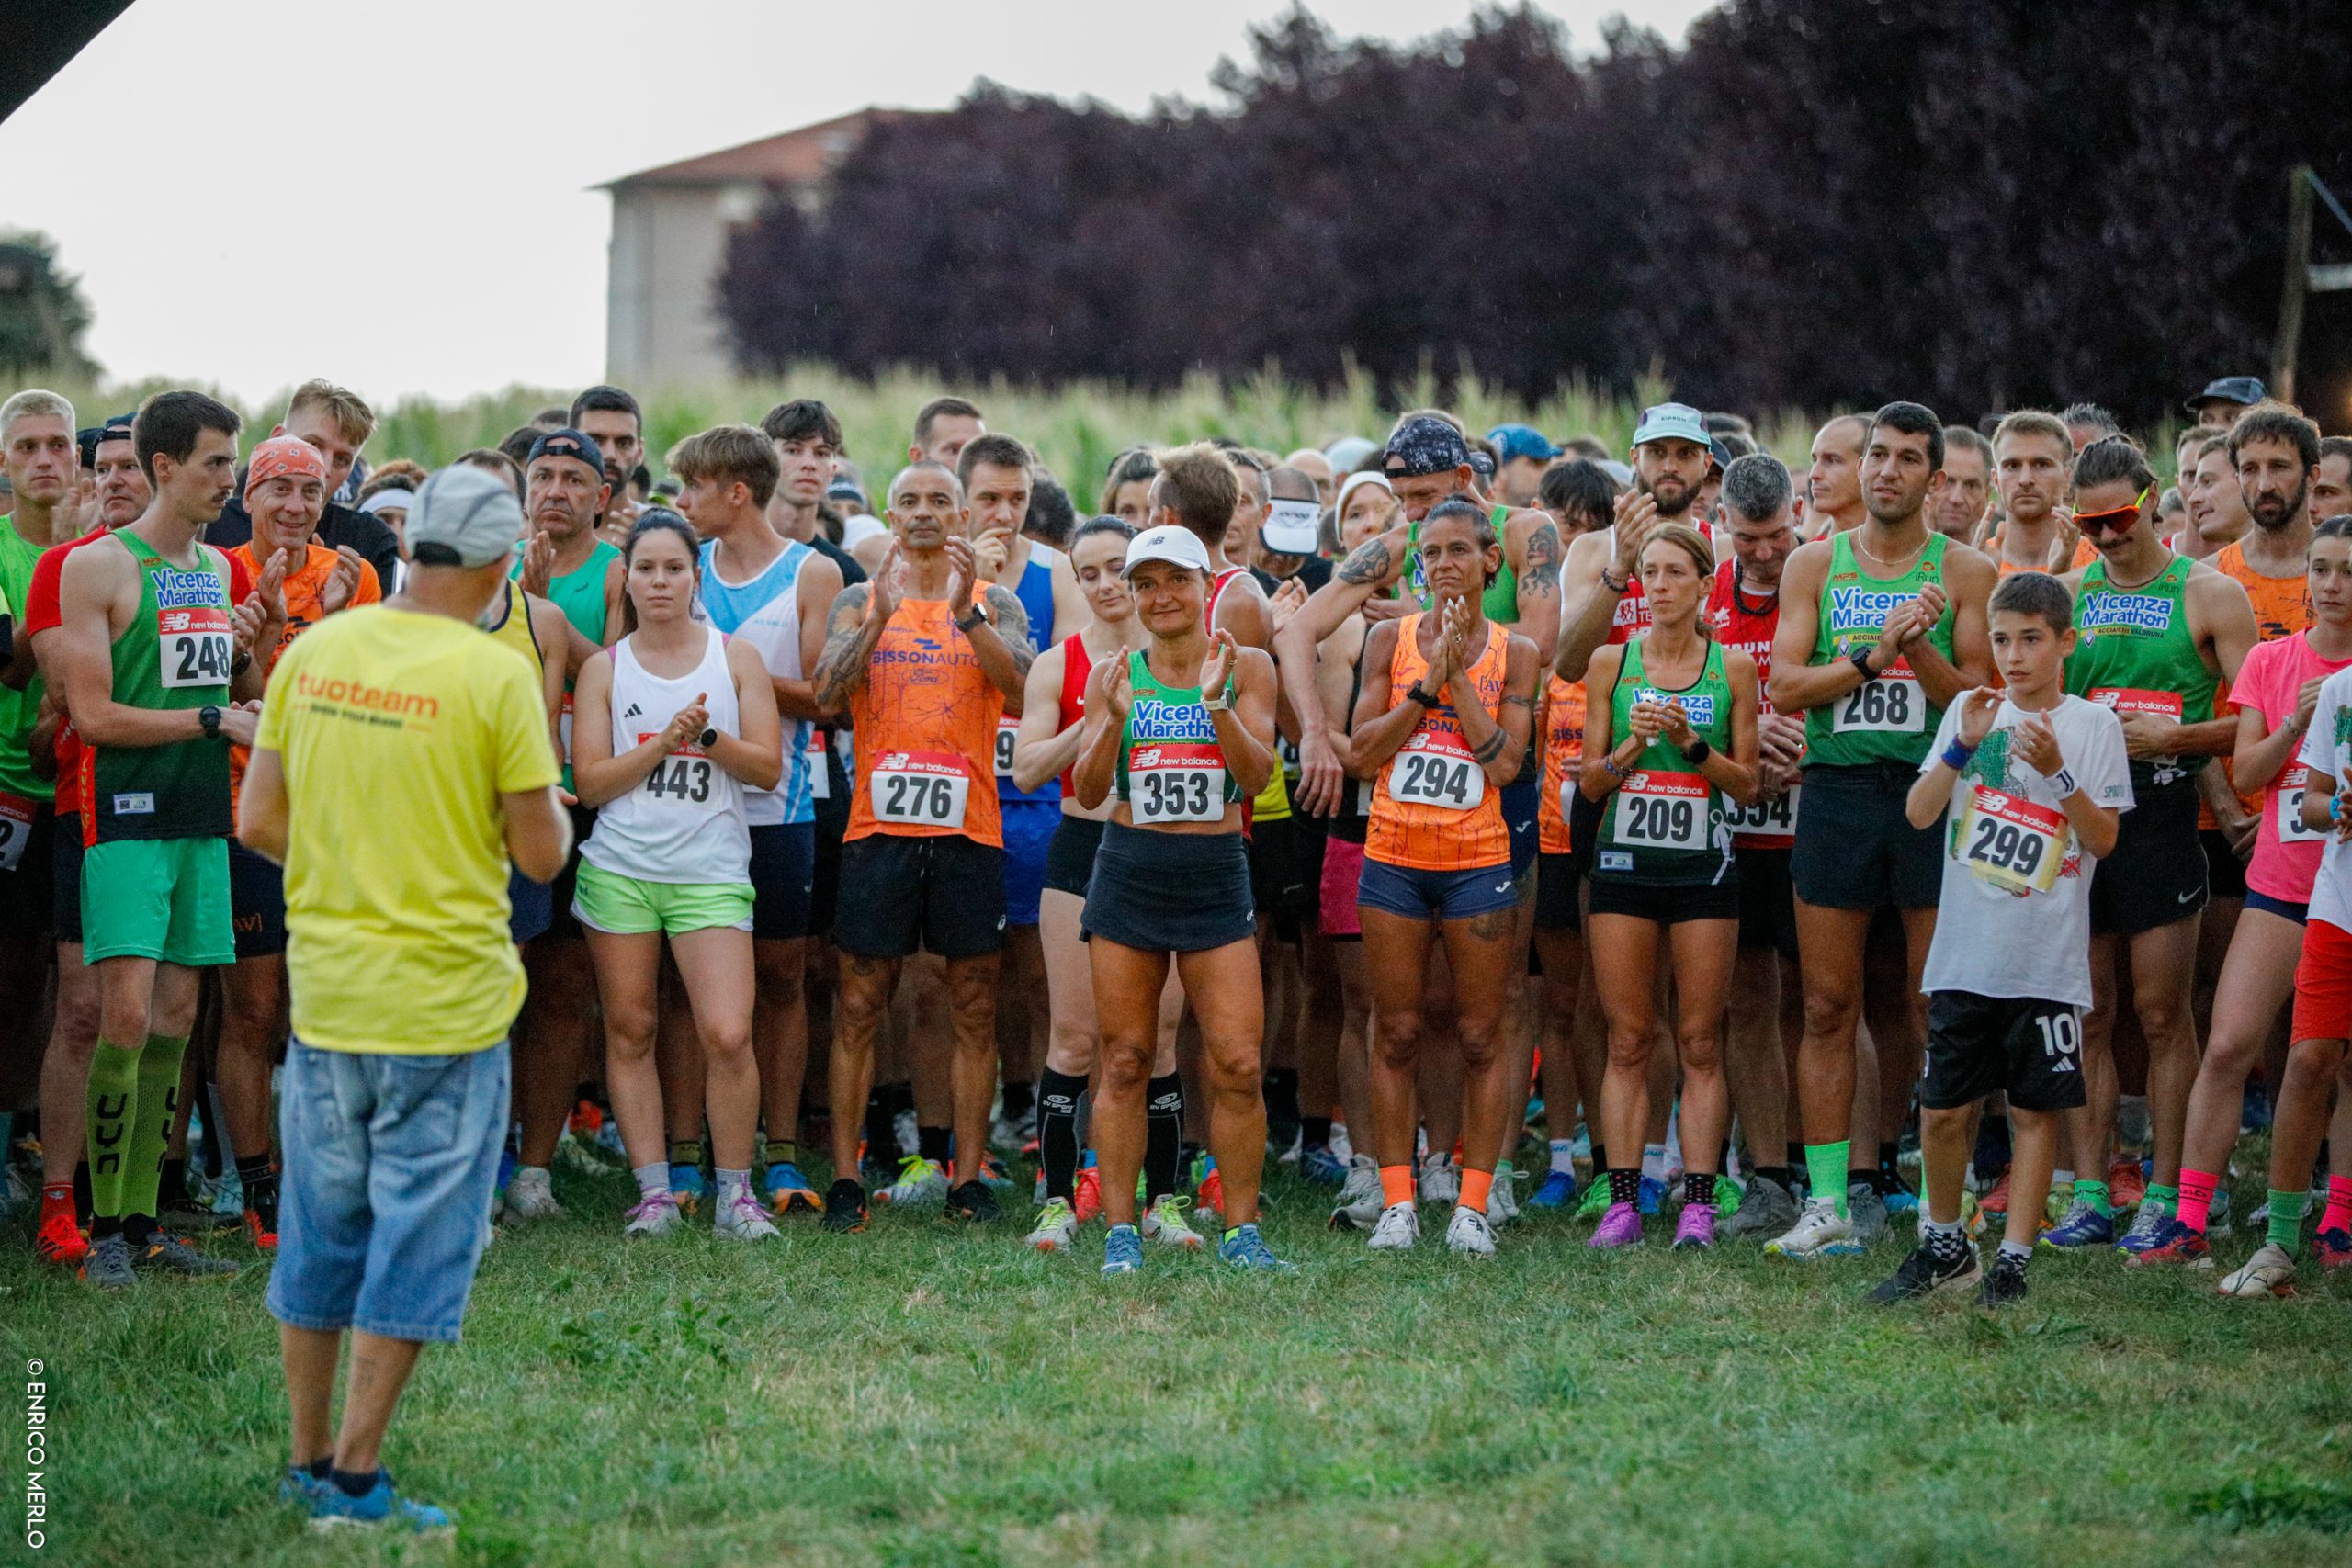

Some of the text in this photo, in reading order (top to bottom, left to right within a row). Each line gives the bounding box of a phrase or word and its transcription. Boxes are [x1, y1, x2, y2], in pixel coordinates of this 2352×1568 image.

[151, 568, 221, 592] Vicenza
[1915, 571, 1939, 584] iRun
[156, 586, 226, 609] Marathon
[1832, 586, 1922, 611] Vicen
[2085, 591, 2175, 616] Vicenza
[1832, 609, 1885, 631] Mara
[2081, 606, 2169, 630] Marathon
[1852, 634, 1882, 642] ACCIAIE
[175, 636, 230, 680] 248
[297, 671, 439, 720] tuoteam
[1843, 682, 1909, 726] 268
[2138, 700, 2176, 713] balance
[1135, 700, 1213, 722] Vicen
[1426, 742, 1445, 752] new
[907, 761, 926, 771] new
[926, 761, 963, 775] balance
[1182, 757, 1219, 766] balance
[646, 758, 711, 803] 443
[1401, 755, 1470, 804] 294
[1646, 784, 1666, 793] new
[1667, 784, 1703, 795] balance
[885, 774, 953, 819] 276
[1143, 772, 1209, 817] 353
[0, 804, 28, 820] alance
[1626, 796, 1693, 842] 209
[2001, 807, 2022, 820] new
[1968, 818, 2044, 878] 299
[2035, 1012, 2077, 1056] 10
